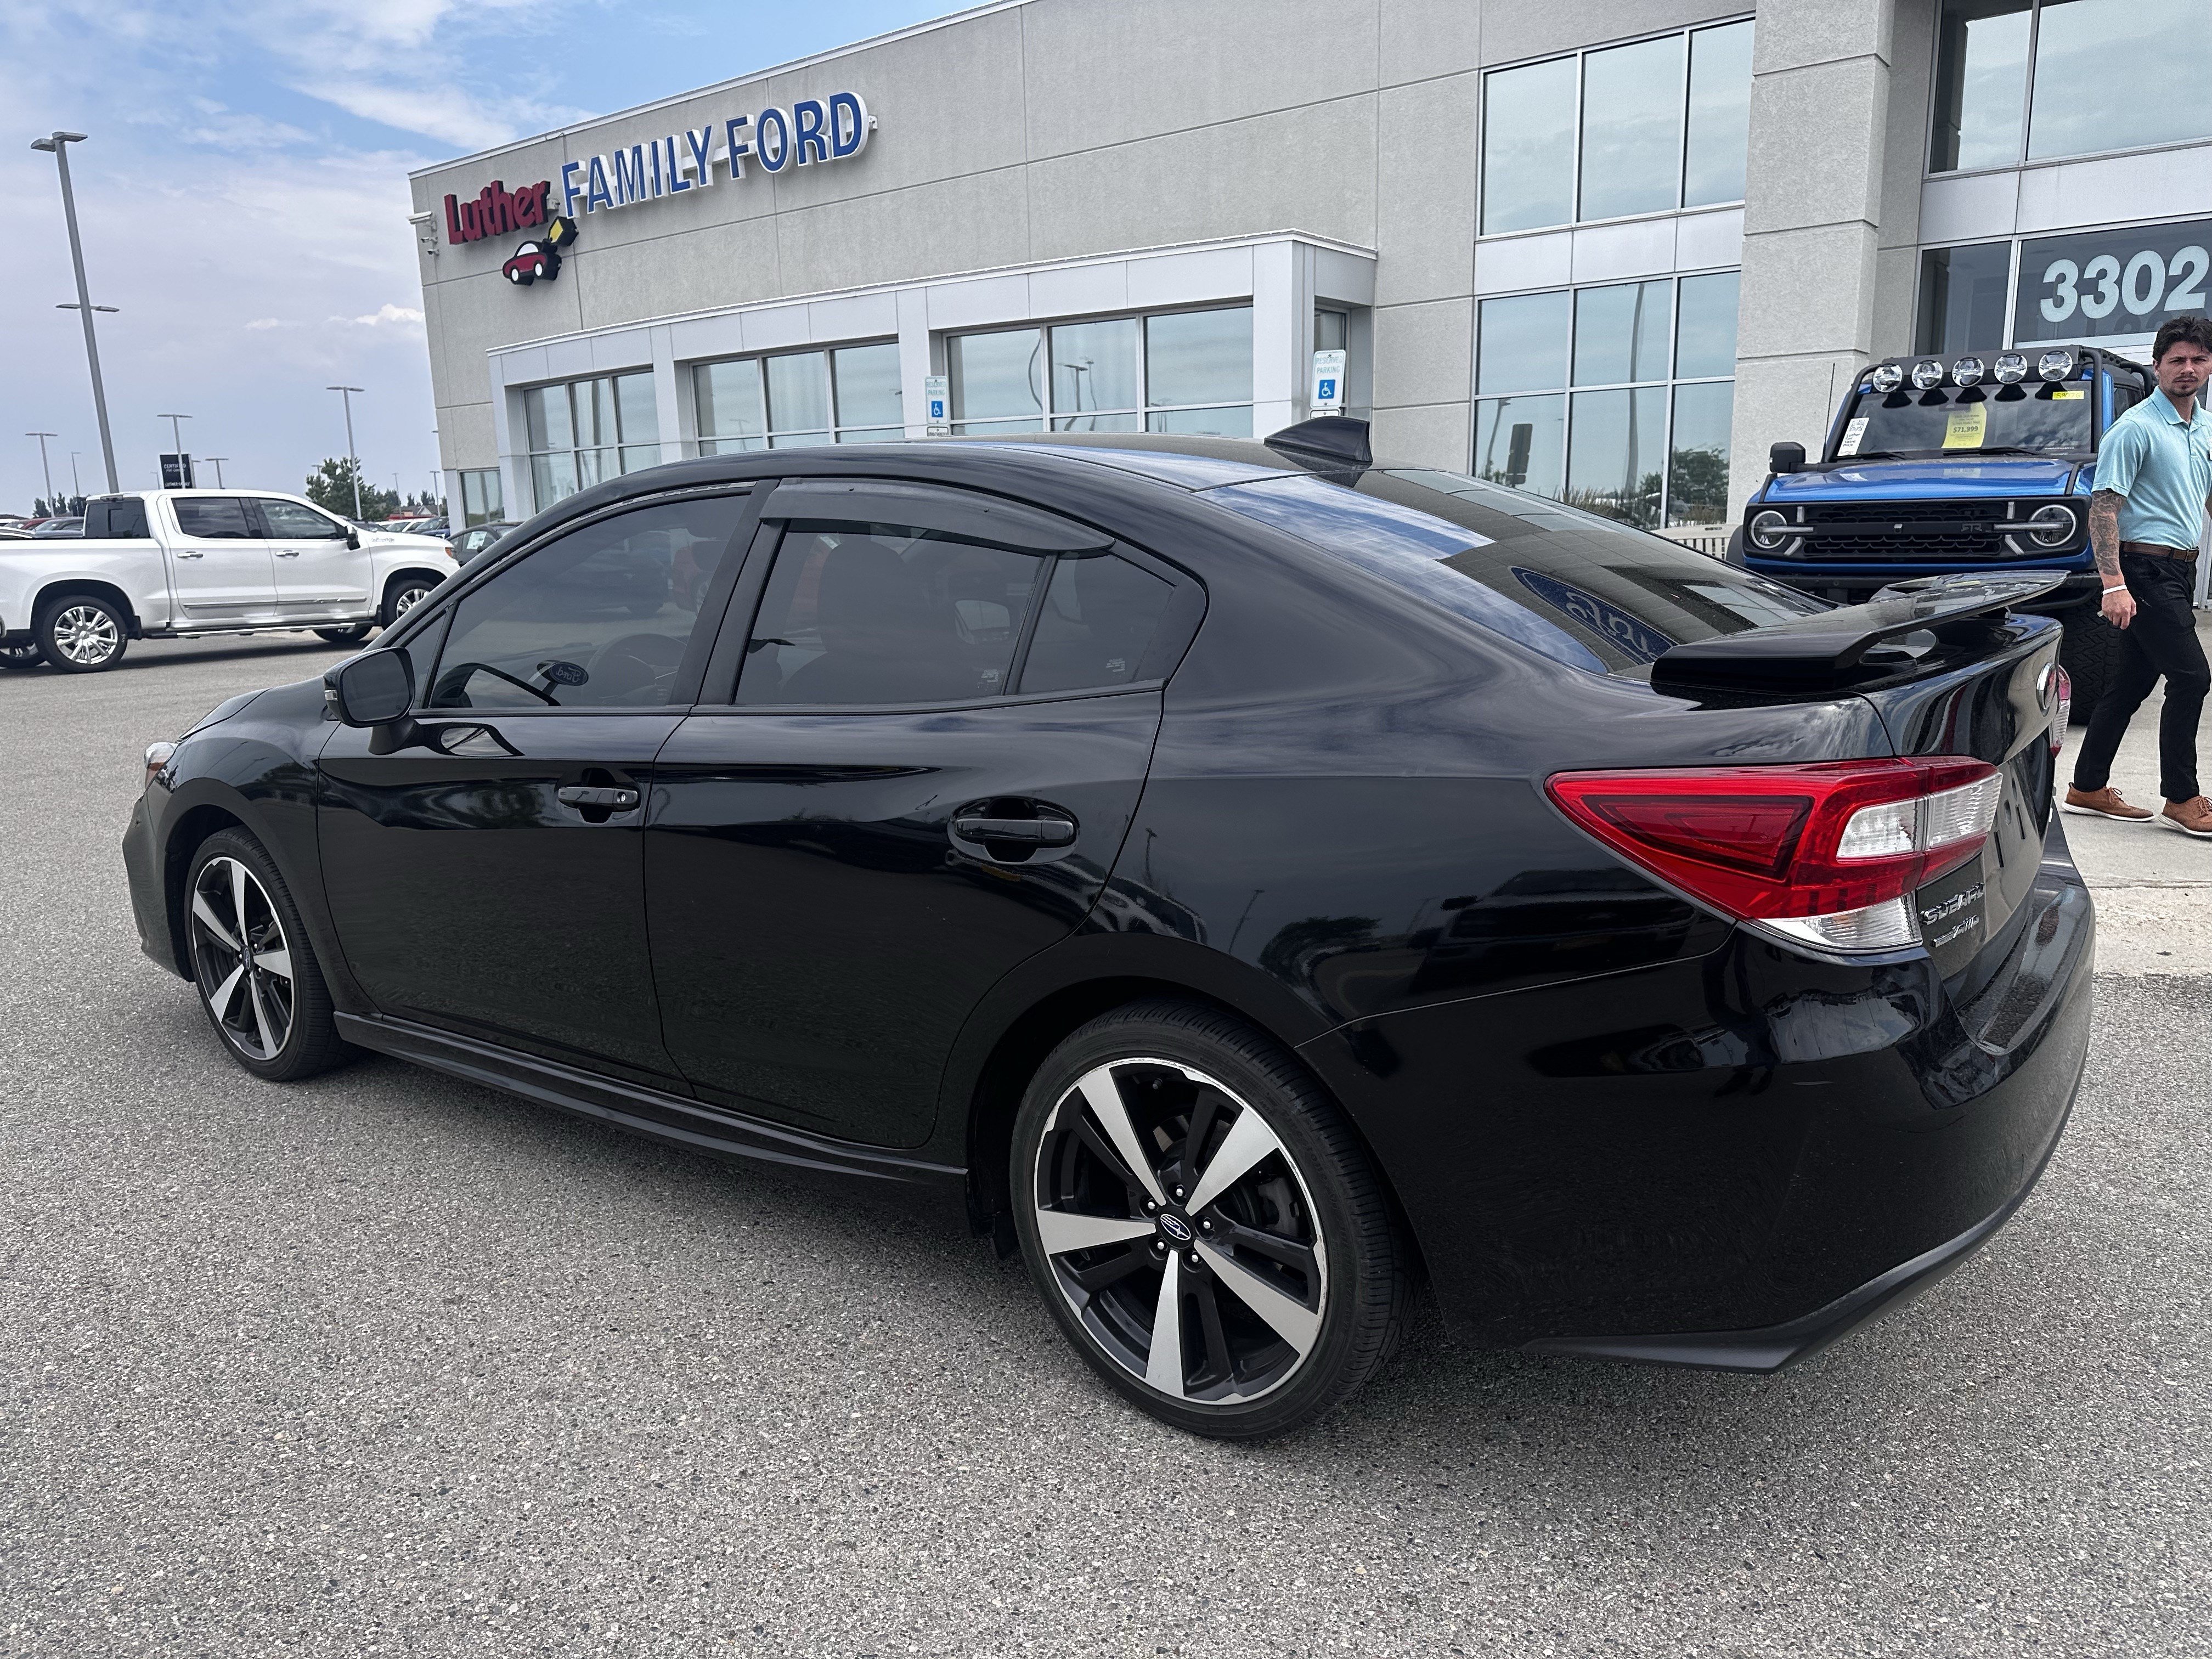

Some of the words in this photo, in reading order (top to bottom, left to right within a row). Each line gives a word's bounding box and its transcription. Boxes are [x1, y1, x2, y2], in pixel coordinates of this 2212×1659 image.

[444, 180, 551, 245] Luther
[561, 124, 713, 219] FAMILY
[725, 91, 869, 180] FORD
[2040, 245, 2210, 323] 3302
[1315, 356, 1344, 364] RESERVED
[1920, 881, 1984, 926] SUBARU
